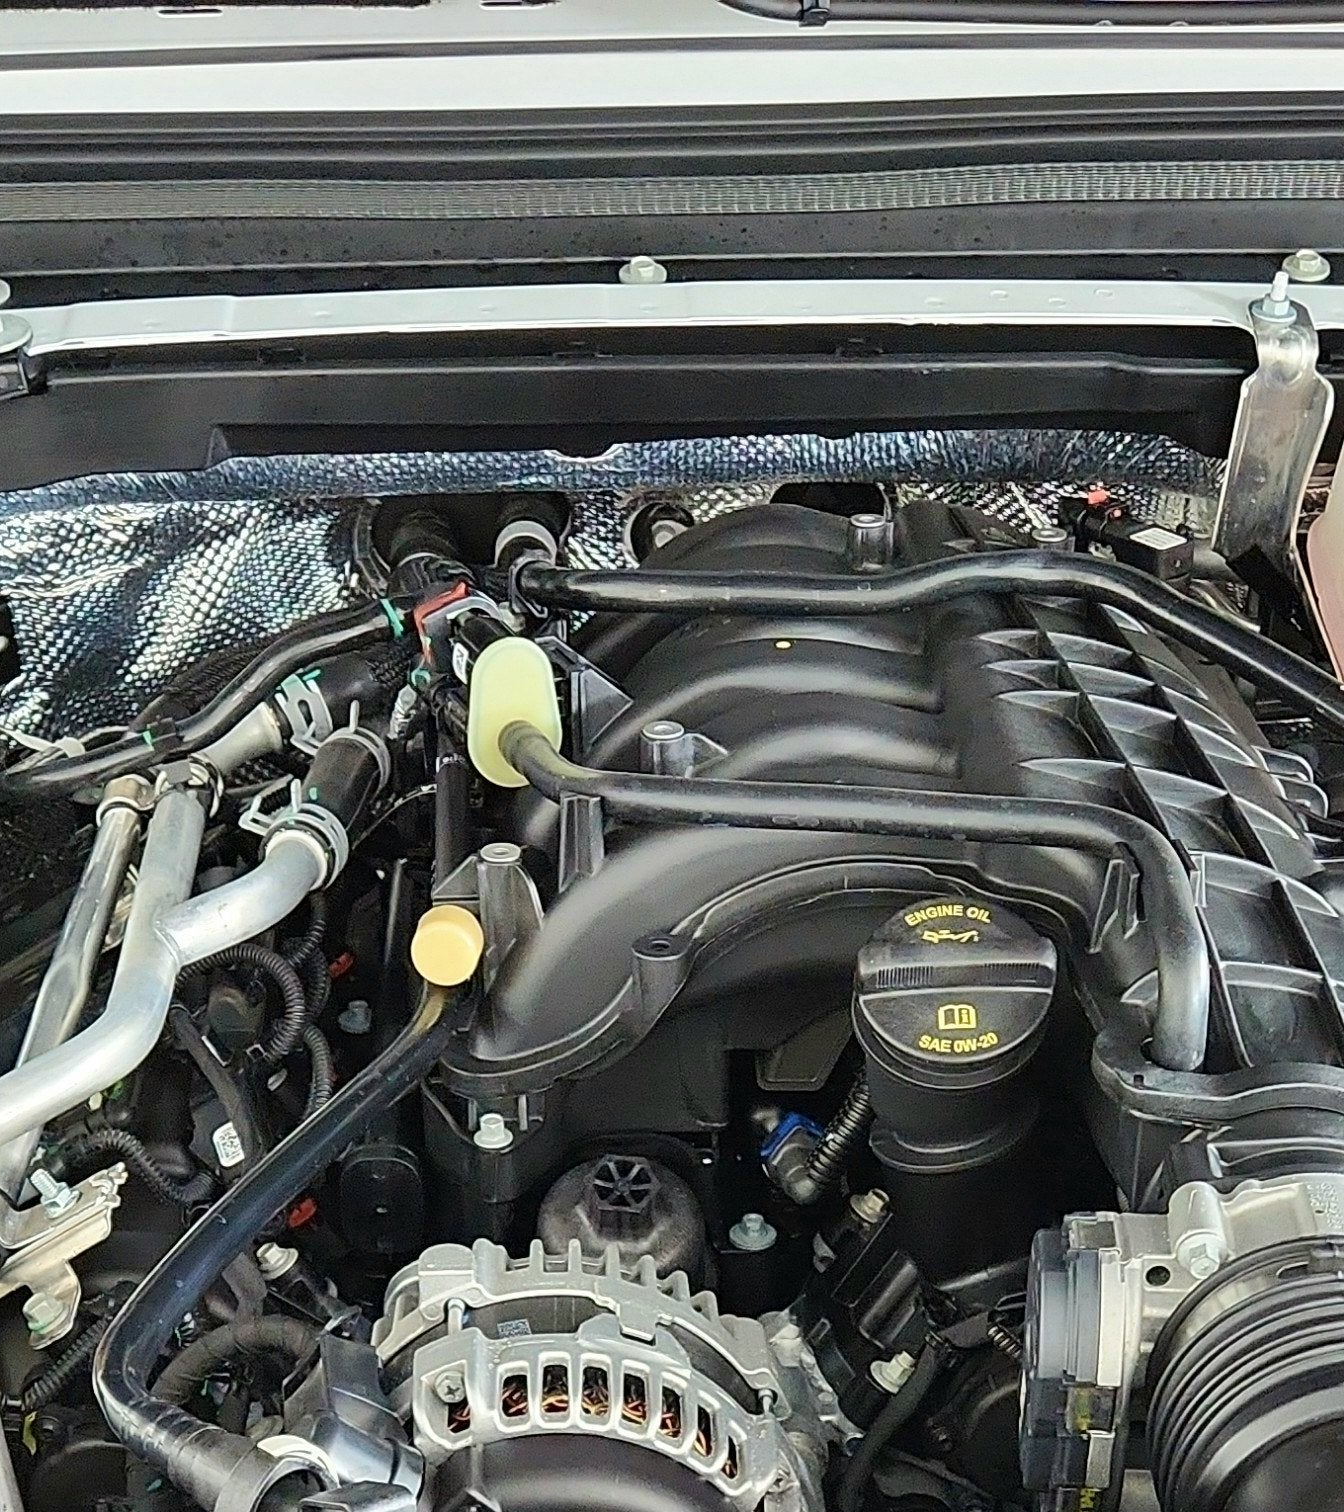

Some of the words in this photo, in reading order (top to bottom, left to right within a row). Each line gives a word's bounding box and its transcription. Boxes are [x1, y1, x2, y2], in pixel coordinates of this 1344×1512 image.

[904, 904, 964, 926] ENGINE
[966, 906, 991, 924] OIL
[918, 1034, 953, 1053] SAE
[953, 1032, 999, 1054] 0W-20
